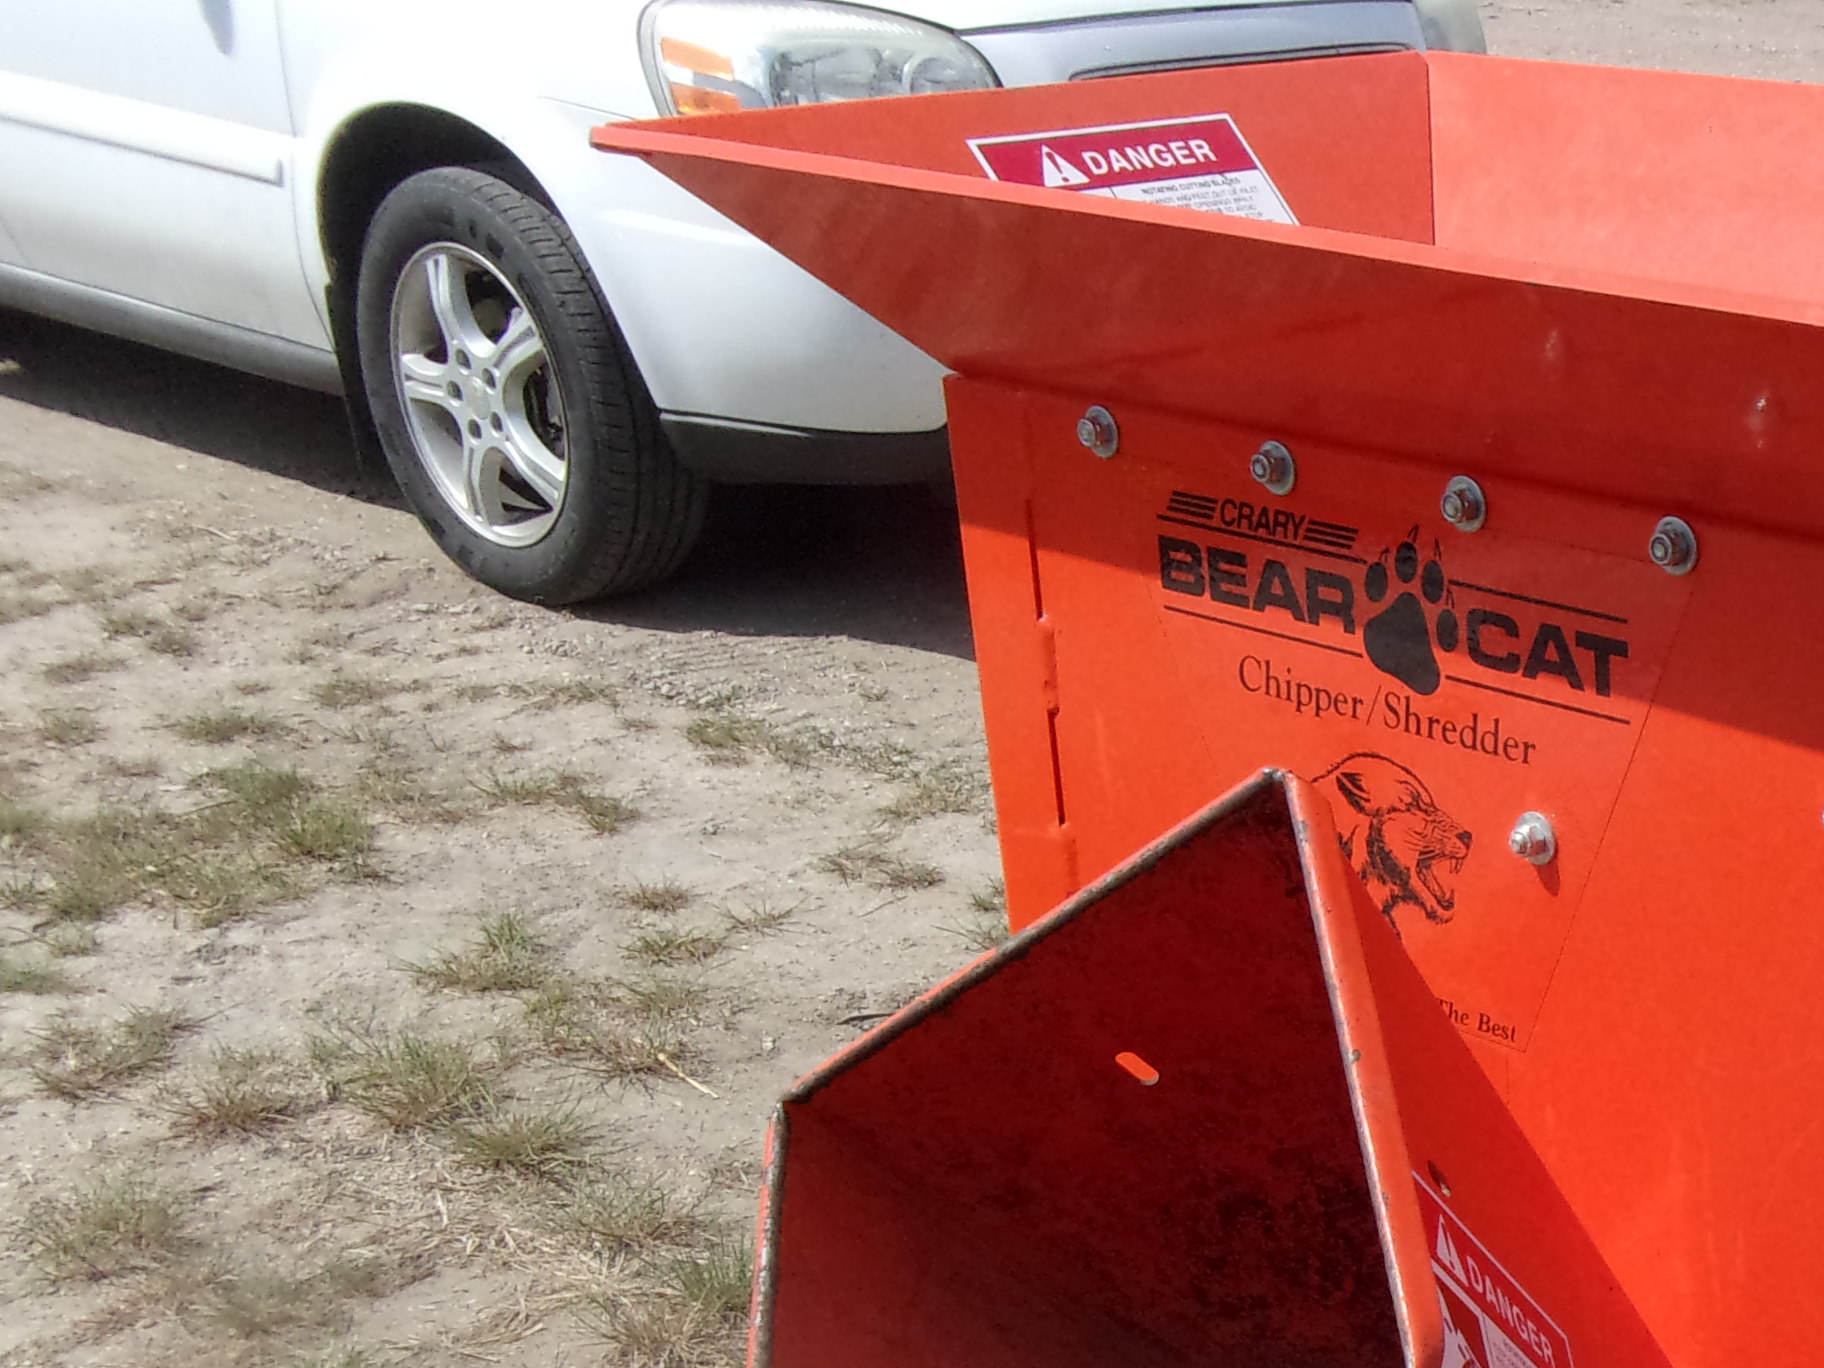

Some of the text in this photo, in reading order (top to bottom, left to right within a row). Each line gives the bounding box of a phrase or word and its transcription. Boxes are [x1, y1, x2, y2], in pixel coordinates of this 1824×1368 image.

[1082, 139, 1217, 175] DANGER
[1220, 499, 1307, 540] CRARY
[1158, 534, 1629, 698] BEAR CAT
[1239, 655, 1536, 766] Chipper/Shredder
[1477, 1012, 1518, 1043] Best
